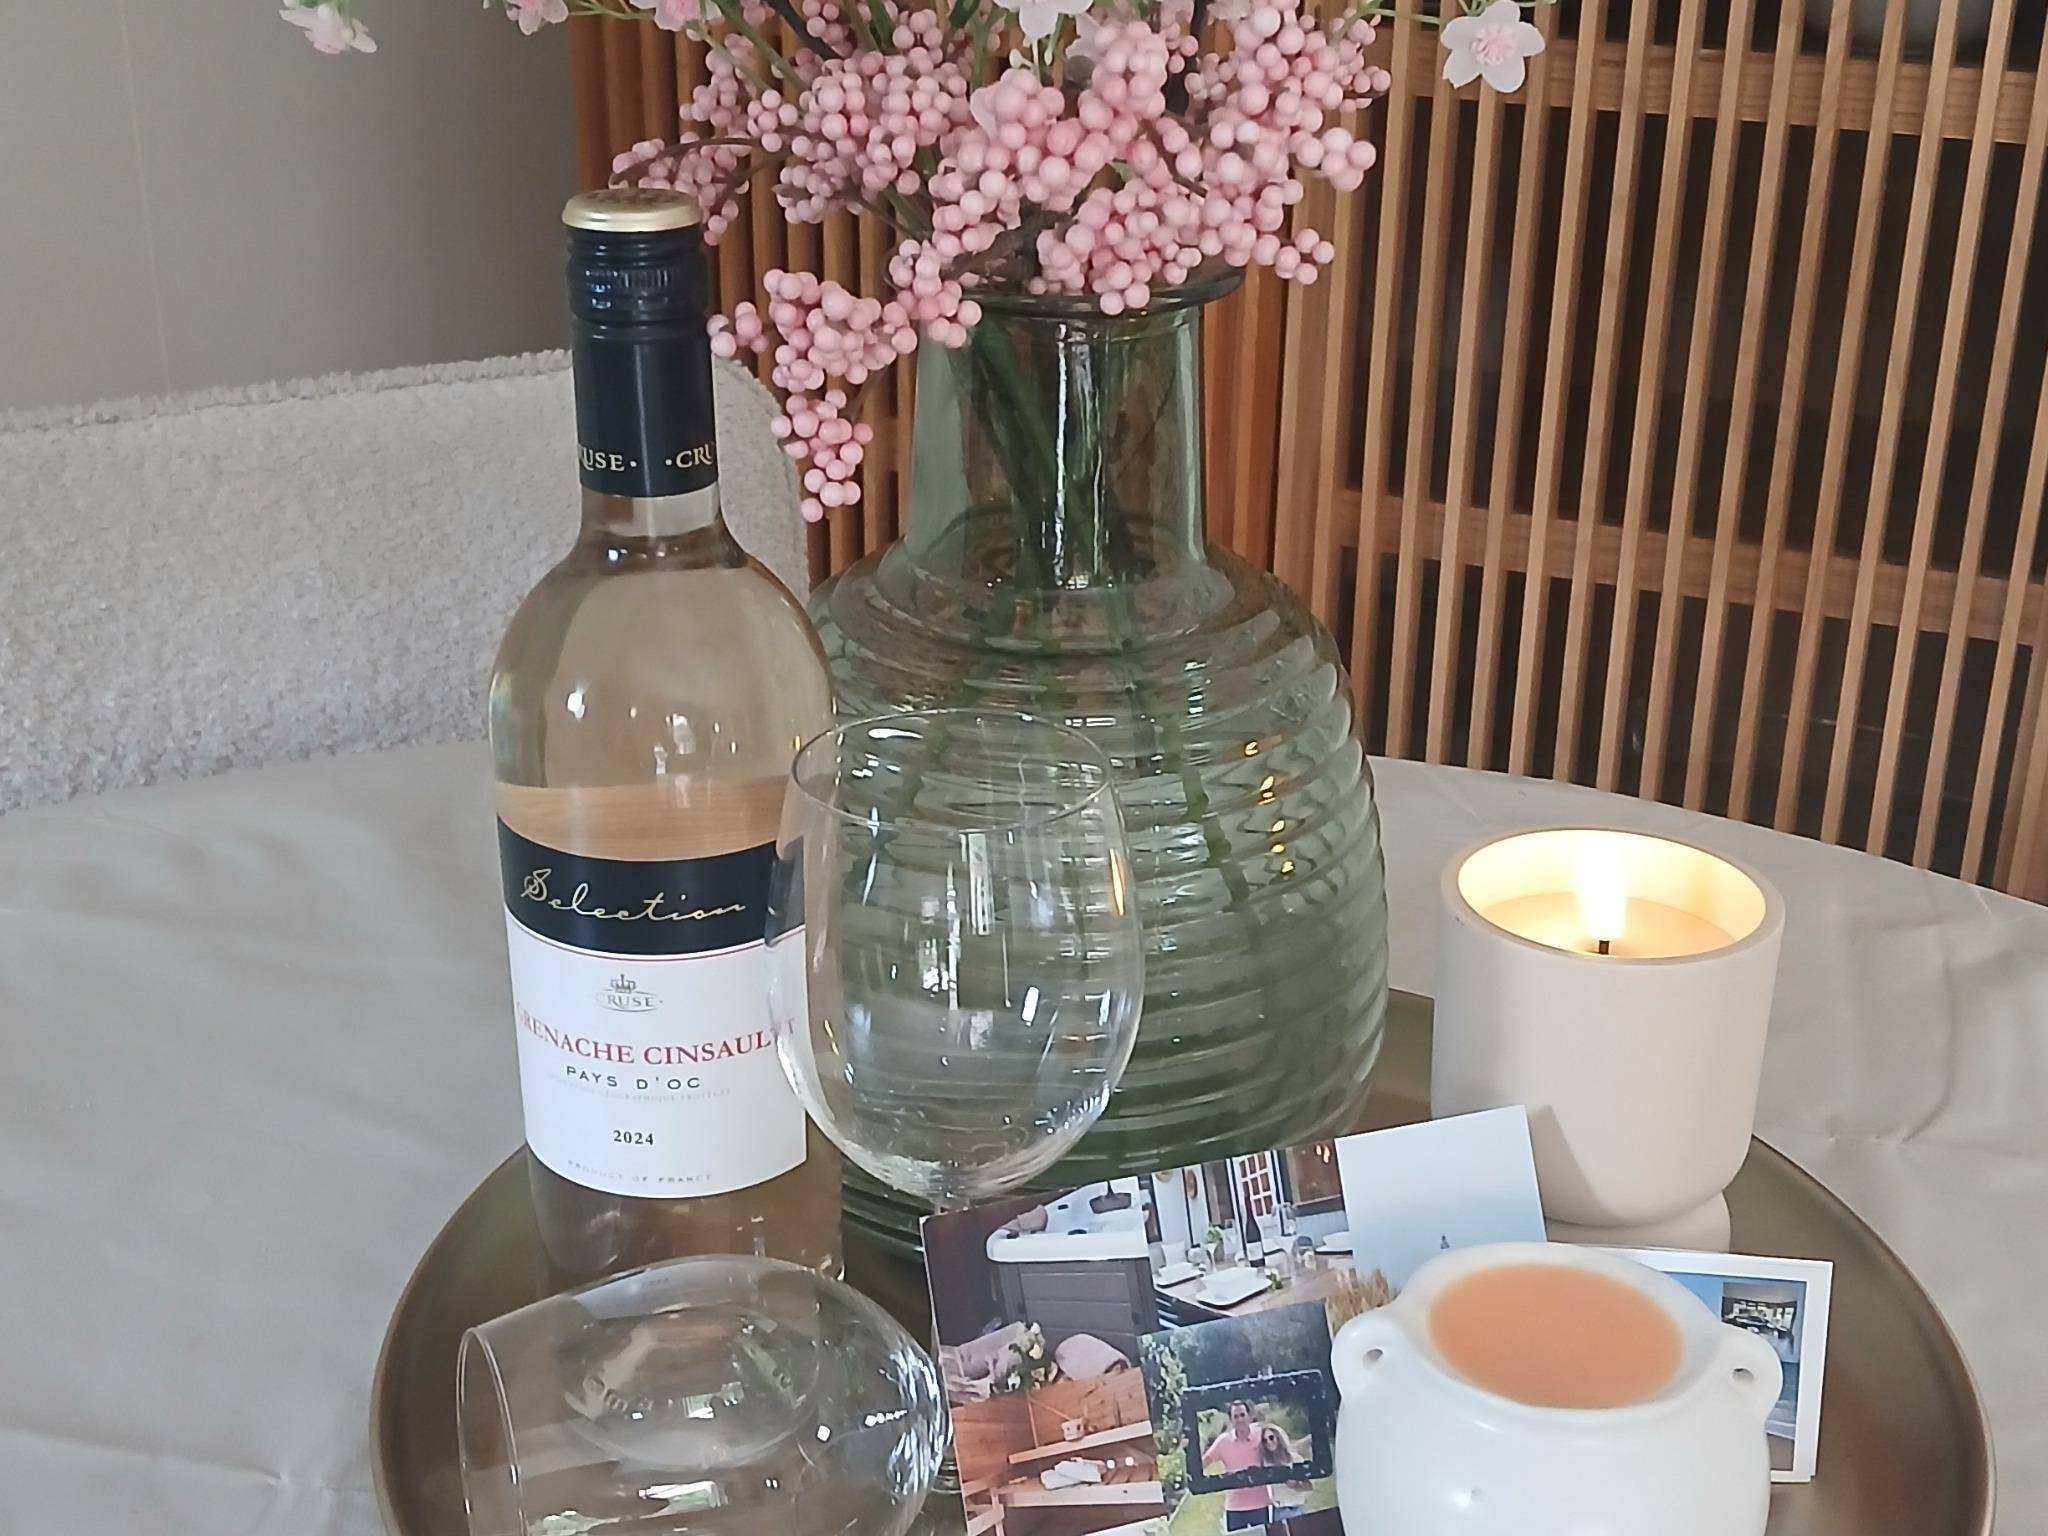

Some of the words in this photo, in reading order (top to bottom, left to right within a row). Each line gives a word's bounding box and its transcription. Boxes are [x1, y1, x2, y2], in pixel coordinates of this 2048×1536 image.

[520, 867, 747, 922] Selection
[566, 1065, 618, 1087] PAYS
[636, 1076, 701, 1090] D'OC
[613, 1129, 655, 1146] 2024
